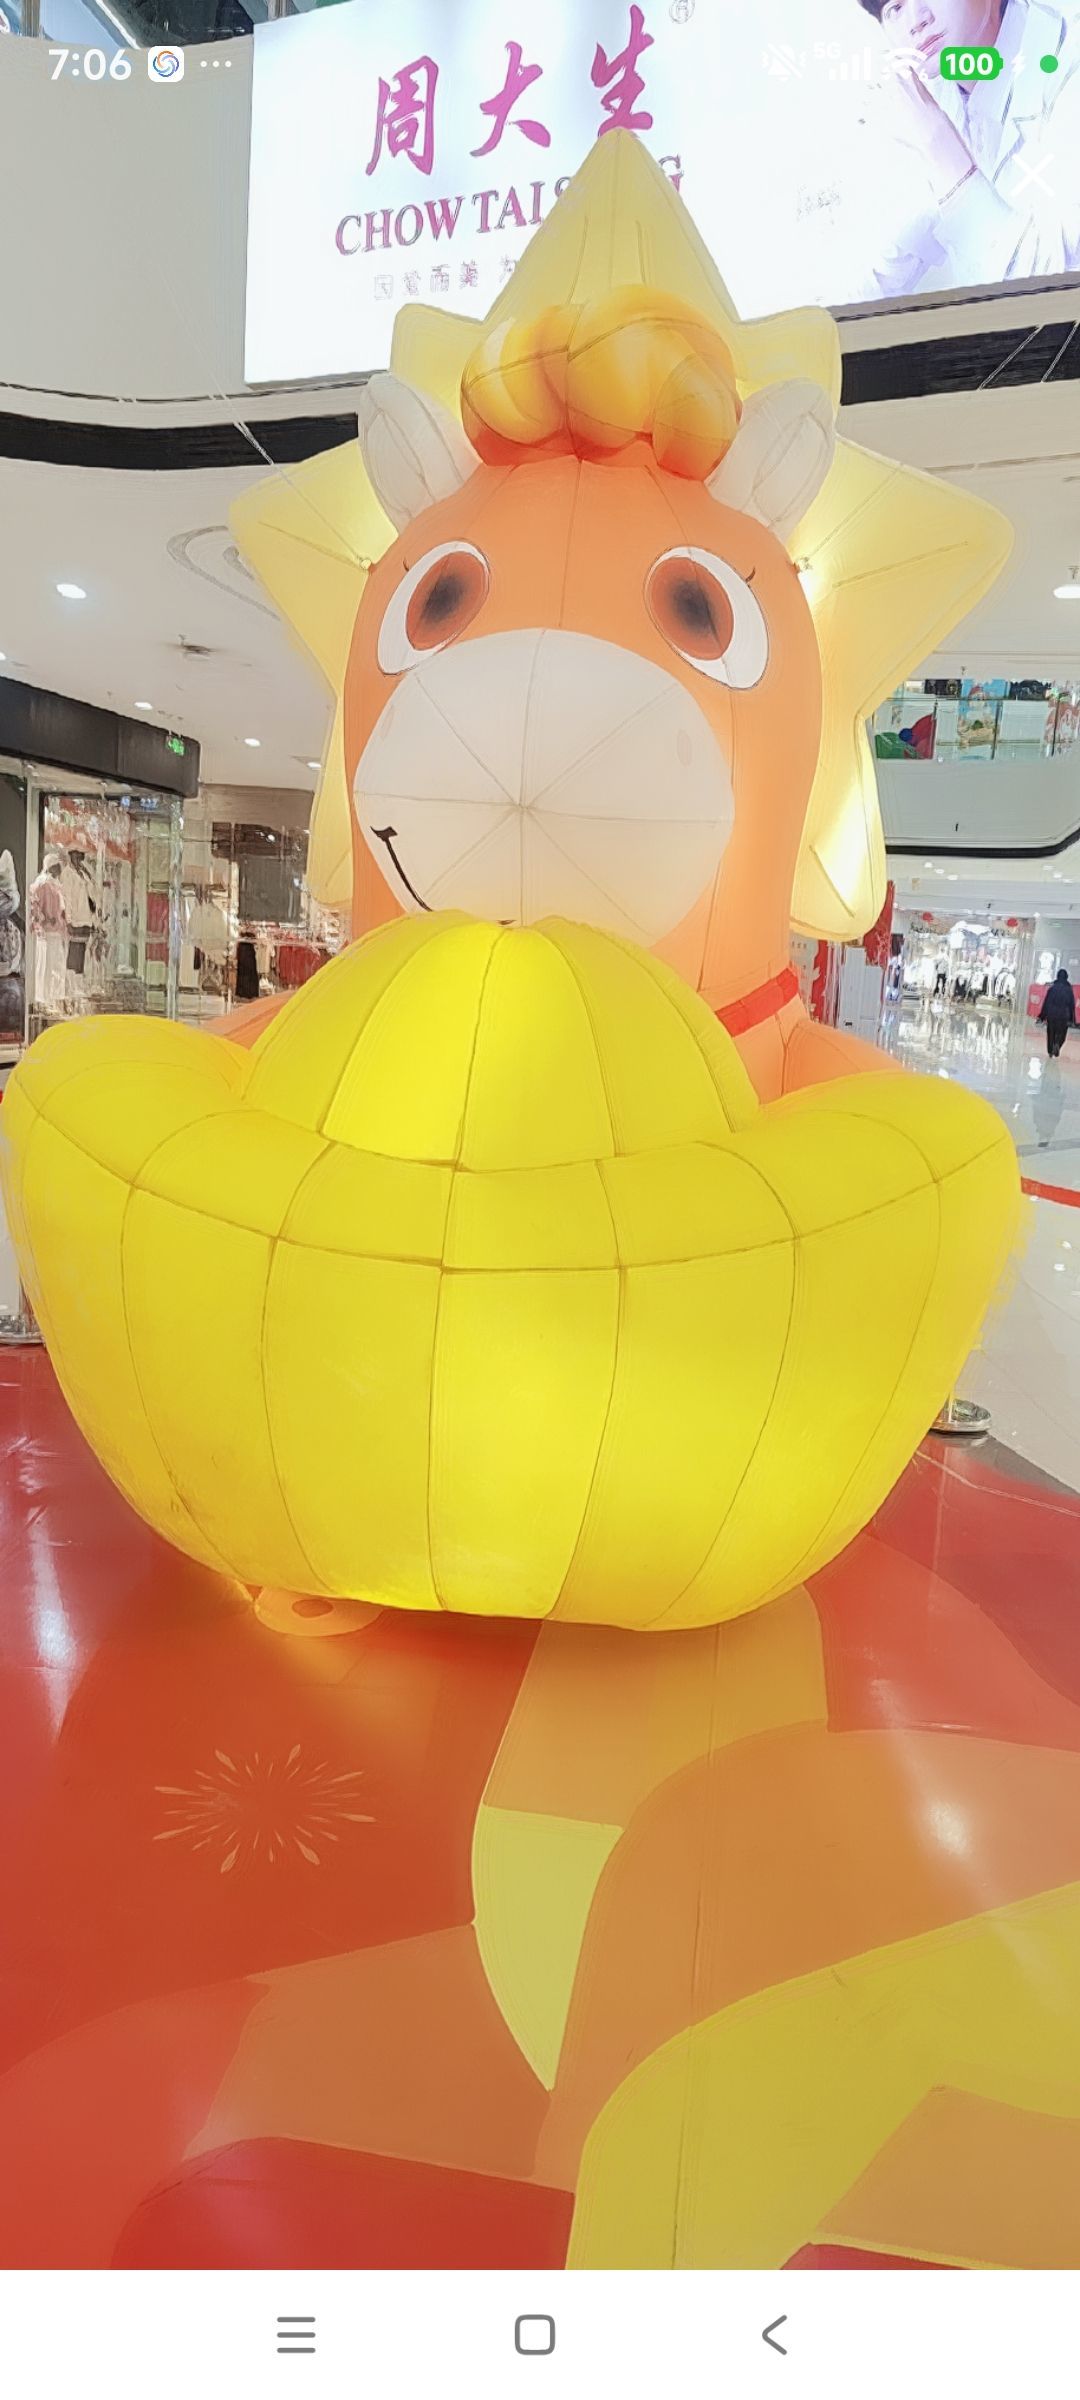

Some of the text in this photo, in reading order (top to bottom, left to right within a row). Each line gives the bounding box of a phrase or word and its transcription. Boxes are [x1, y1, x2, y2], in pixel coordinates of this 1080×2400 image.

[365, 4, 655, 176] 周大生
[335, 195, 466, 256] CHOW
[471, 180, 546, 235] TAI
